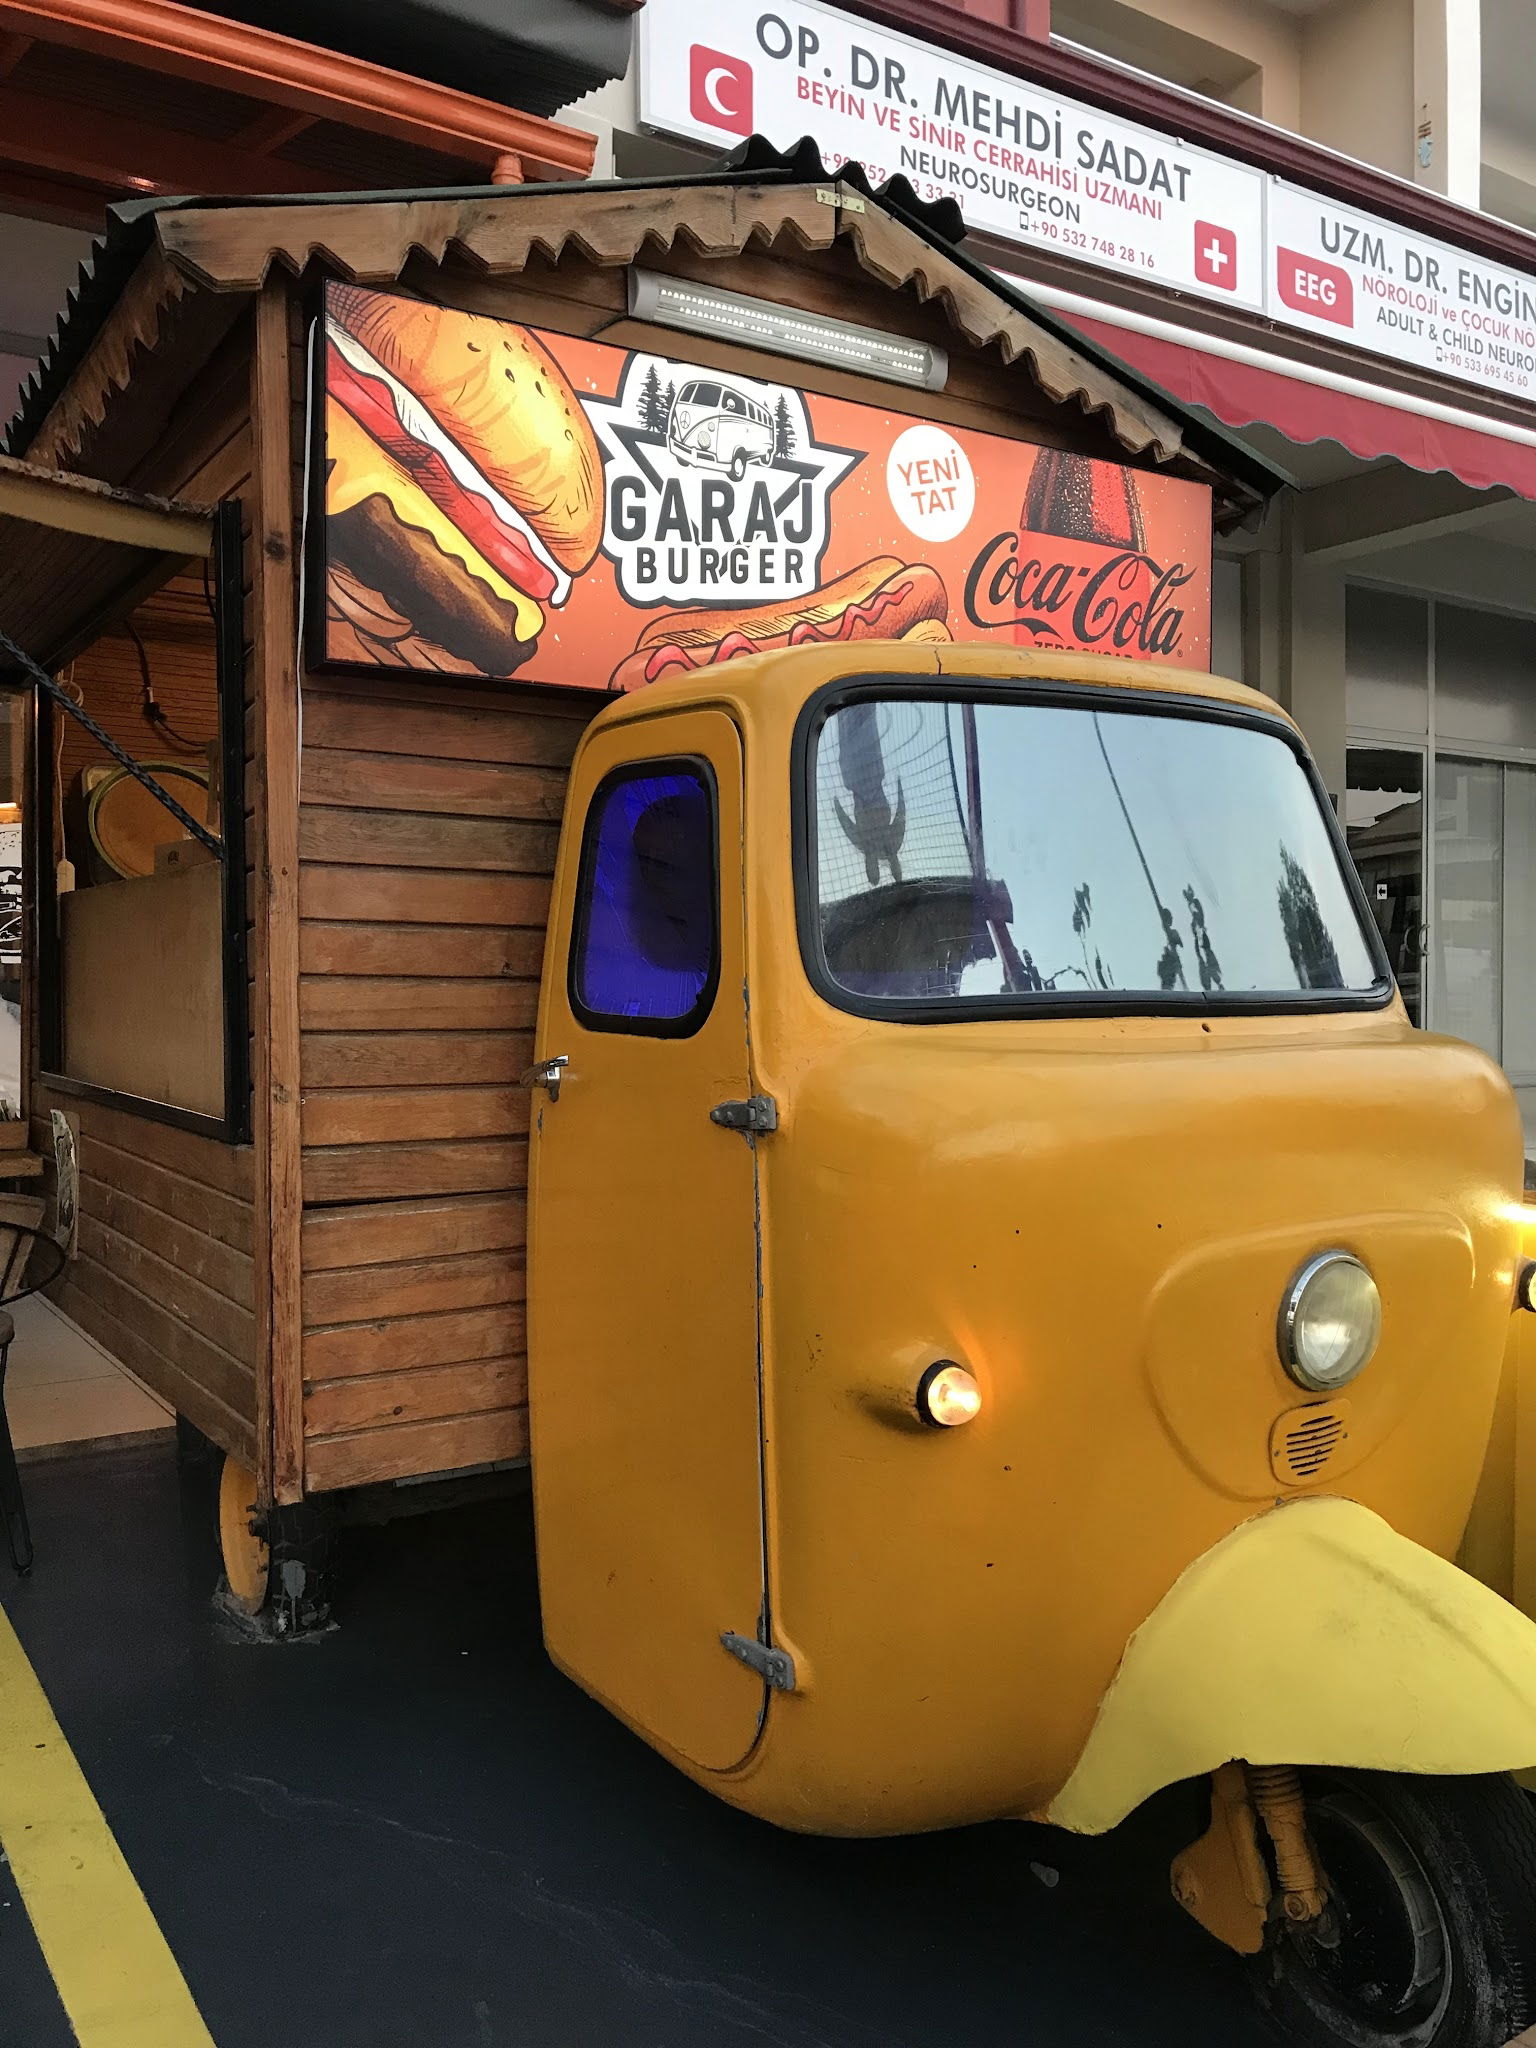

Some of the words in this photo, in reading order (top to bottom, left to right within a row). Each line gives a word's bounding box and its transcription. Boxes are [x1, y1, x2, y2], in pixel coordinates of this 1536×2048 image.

[756, 13, 832, 78] OP.
[851, 45, 918, 108] DR.
[934, 77, 1062, 159] MEHDİ
[1077, 130, 1191, 202] SADAT
[797, 76, 865, 120] BEYİN
[873, 102, 900, 132] VE
[908, 114, 966, 155] SİNİR
[973, 139, 1078, 193] CERRAHİSİ
[1085, 176, 1162, 221] UZMANI
[901, 145, 1081, 224] NEUROSURGEON
[1031, 221, 1058, 239] +90
[1062, 228, 1087, 248] 532
[1091, 236, 1115, 257] 748
[1119, 246, 1135, 263] 28
[1140, 251, 1155, 268] 16
[1320, 216, 1394, 275] UZM.
[1404, 248, 1448, 294] DR.
[1294, 268, 1337, 306] EEG
[1362, 274, 1438, 316] NÖROLOJİ
[1441, 307, 1457, 322] ve
[1461, 309, 1510, 341] ÇOCUK
[1376, 306, 1424, 336] ADULT
[1428, 323, 1438, 342] &
[1442, 328, 1483, 355] CHILD
[1488, 342, 1536, 374] NEURO
[1442, 352, 1462, 367] +90
[1464, 357, 1481, 373] 533
[1503, 369, 1514, 383] 45
[896, 448, 960, 487] YENİ
[910, 486, 957, 515] TAT
[610, 475, 813, 544] GARAJ
[636, 547, 804, 585] BURGER
[963, 531, 1197, 656] Coca-Cola
